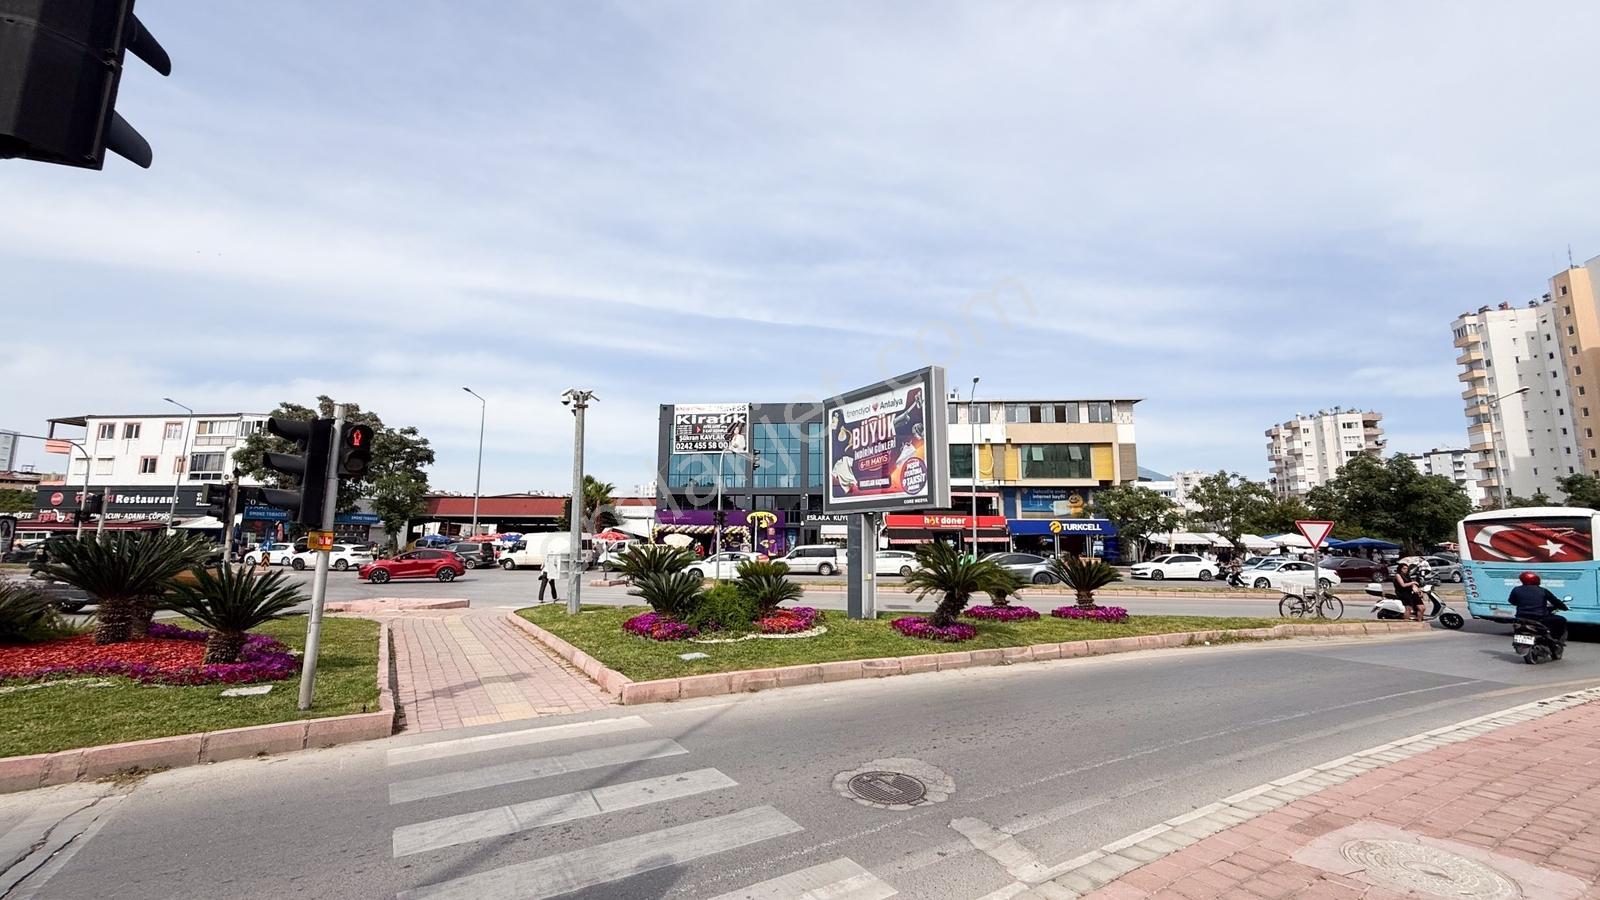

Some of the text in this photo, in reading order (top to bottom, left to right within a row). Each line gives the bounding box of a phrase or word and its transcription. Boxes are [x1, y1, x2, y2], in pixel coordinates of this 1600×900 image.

[846, 398, 904, 418] trendyol Antalya
[677, 414, 746, 425] Kiralık
[852, 413, 896, 450] BÜYÜK
[854, 438, 896, 460] İNDİRİM GÜNLERİ
[860, 454, 888, 468] 6-11 MAYIS
[115, 494, 179, 504] Restaurant
